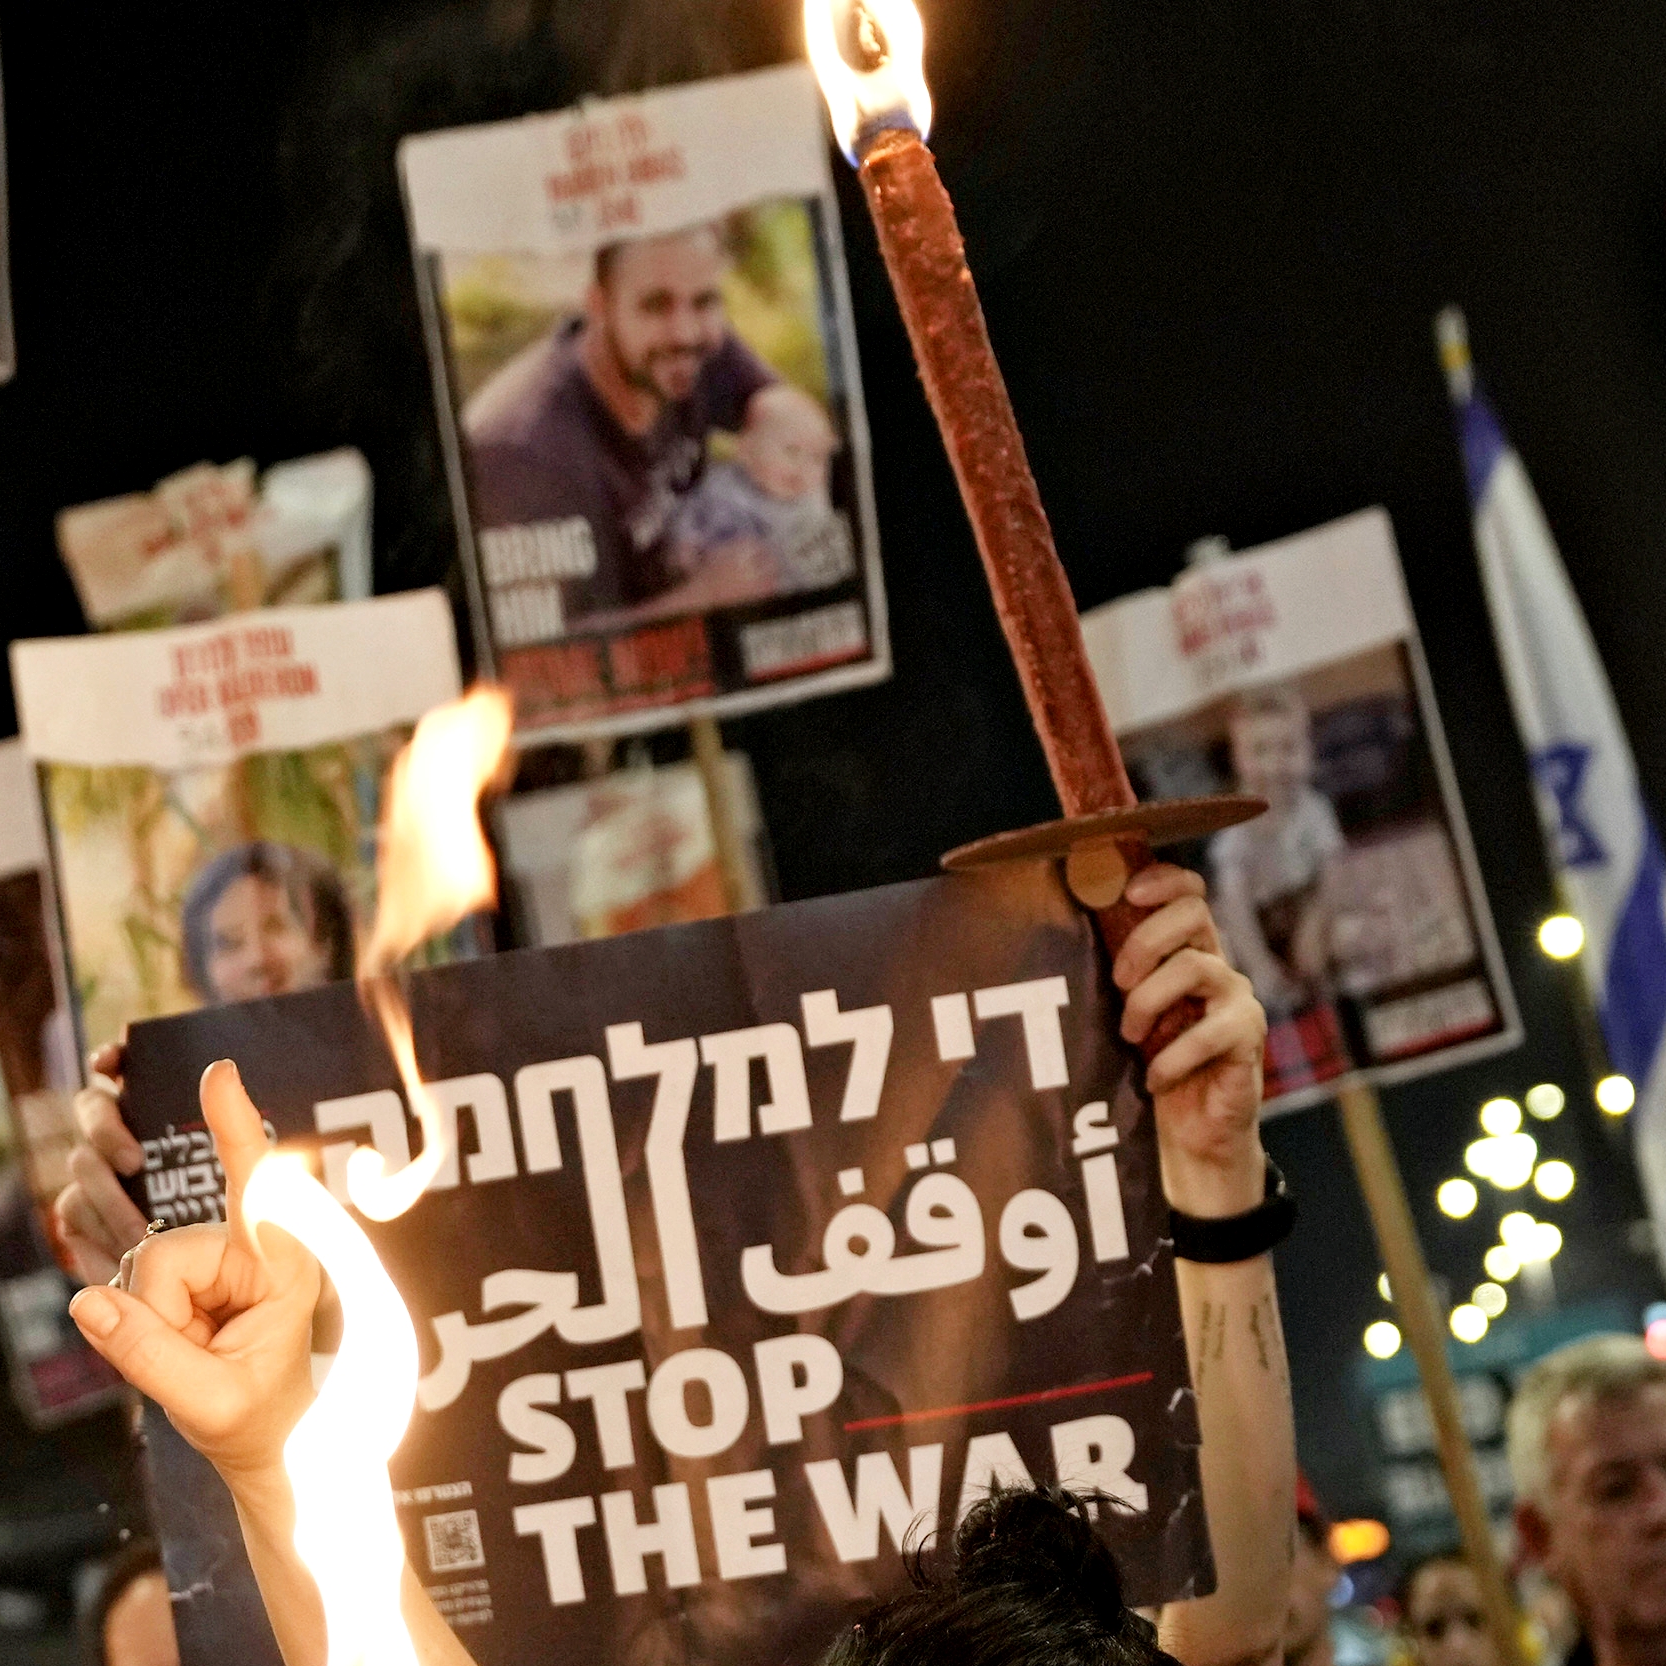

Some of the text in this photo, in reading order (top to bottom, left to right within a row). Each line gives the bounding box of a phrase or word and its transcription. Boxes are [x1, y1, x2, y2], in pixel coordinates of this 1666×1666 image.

[314, 975, 1071, 1212] די למלחמה
[740, 1102, 1130, 1322] أوقف
[496, 1333, 844, 1486] STOP
[513, 1414, 1150, 1608] THE WAR
